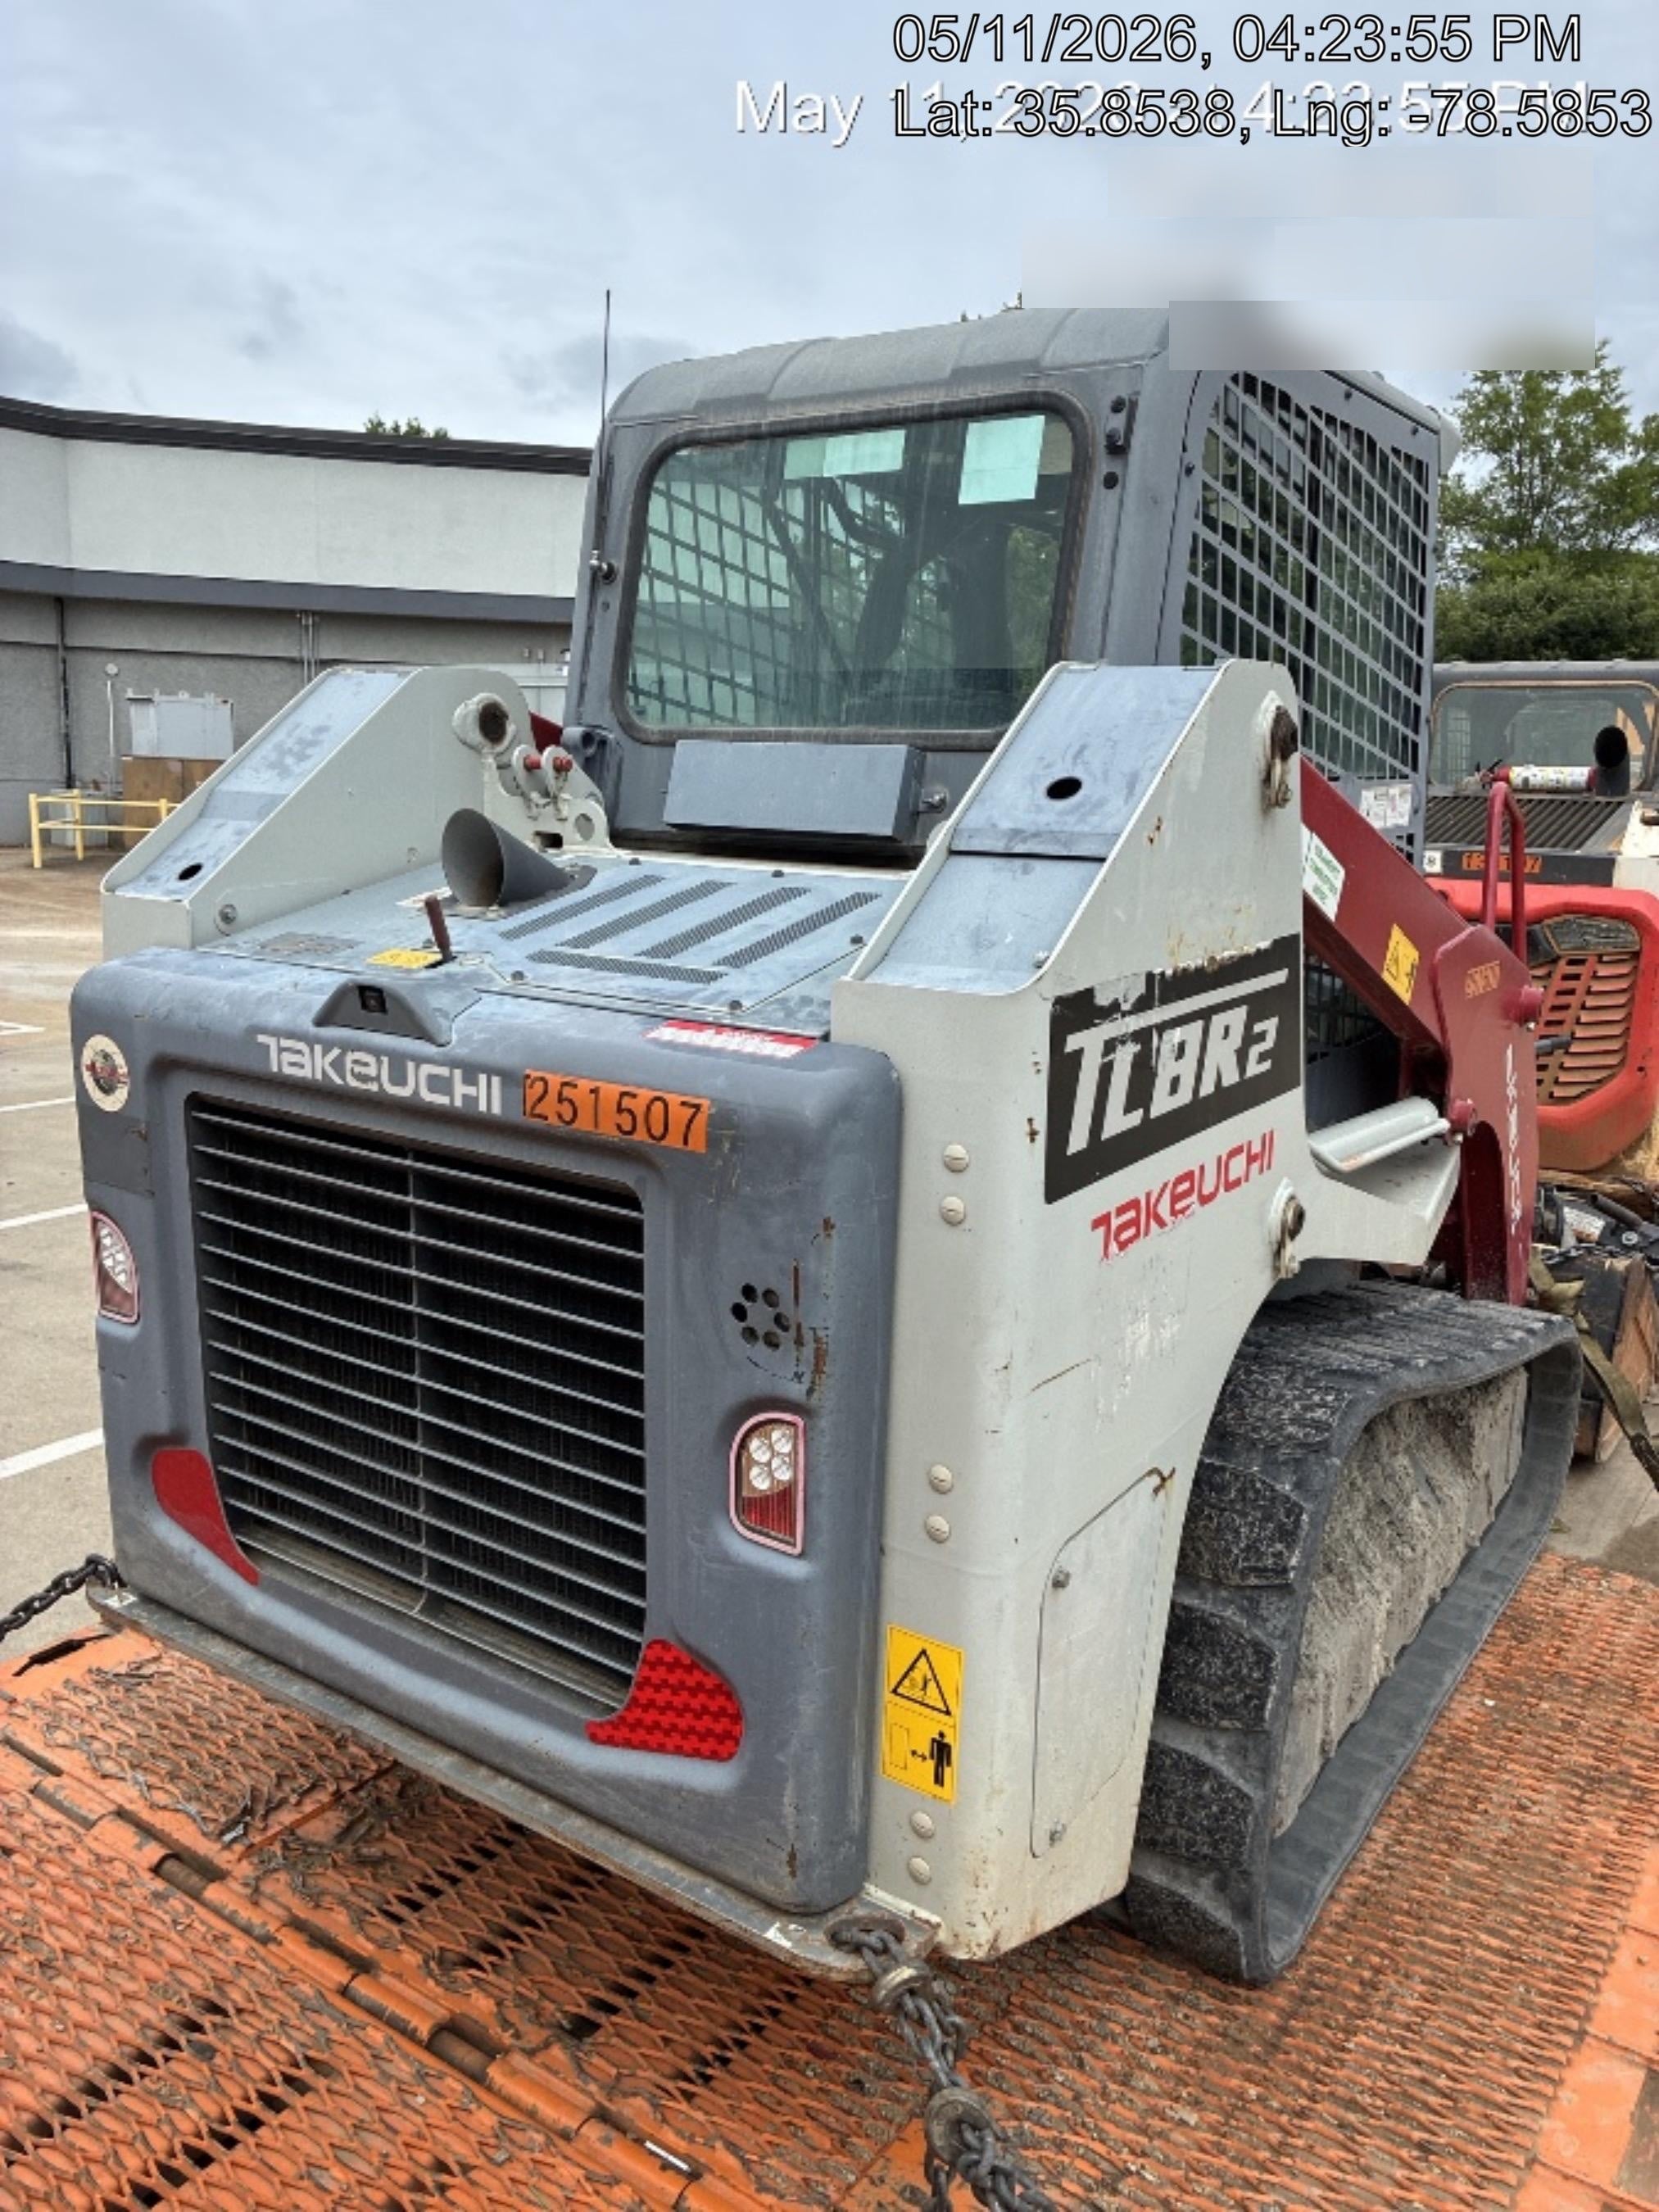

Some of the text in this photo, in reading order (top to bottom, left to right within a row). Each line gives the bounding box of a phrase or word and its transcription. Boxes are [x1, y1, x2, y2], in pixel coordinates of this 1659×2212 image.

[256, 1033, 502, 1117] TAKEUCHI
[525, 1074, 703, 1146] 251507
[1090, 1129, 1276, 1262] TAKEUCHI
